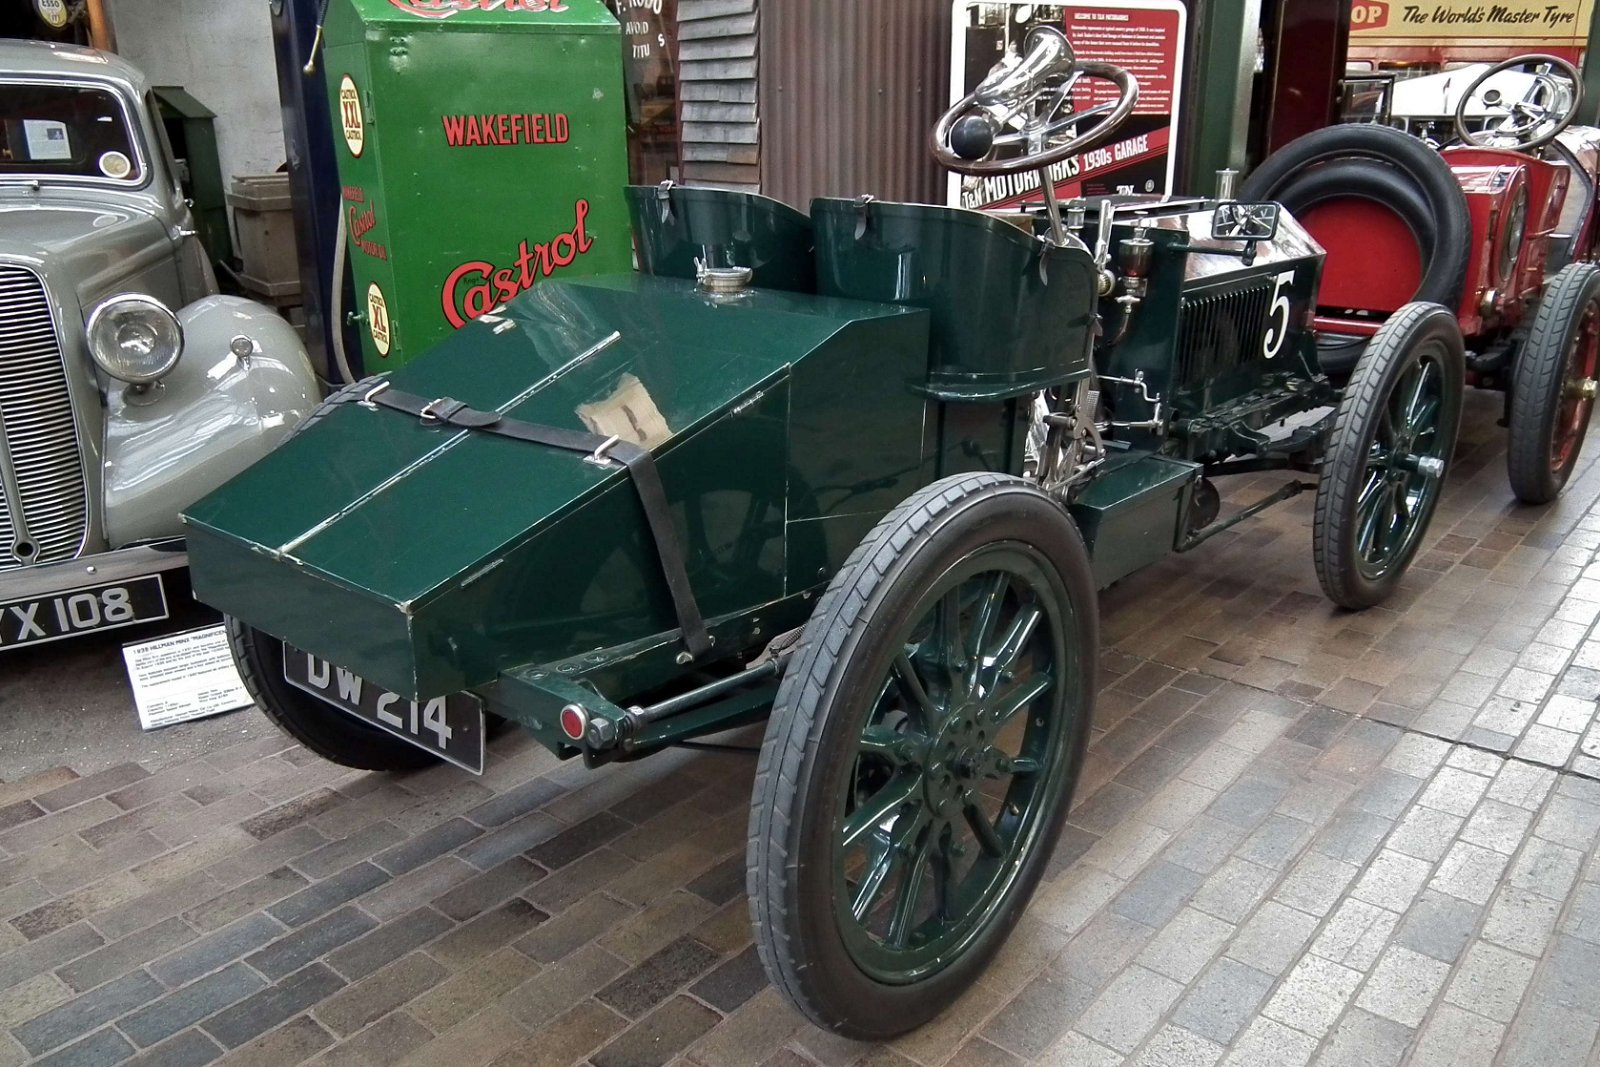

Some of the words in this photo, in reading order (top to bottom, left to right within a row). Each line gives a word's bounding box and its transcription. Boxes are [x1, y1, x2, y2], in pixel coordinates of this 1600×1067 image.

[1402, 5, 1429, 24] The
[1431, 5, 1486, 24] World's
[1486, 5, 1540, 24] Master
[1542, 5, 1575, 29] Tyre
[342, 100, 361, 129] XXL
[442, 113, 570, 146] WAKEFIELD
[962, 187, 983, 210] T&N
[1083, 148, 1113, 172] 1930s
[1114, 134, 1149, 161] GARAGE
[441, 199, 593, 329] Castrol
[372, 303, 387, 333] XL
[1263, 270, 1295, 359] 5
[54, 586, 134, 632] 108
[376, 692, 453, 750] 214
